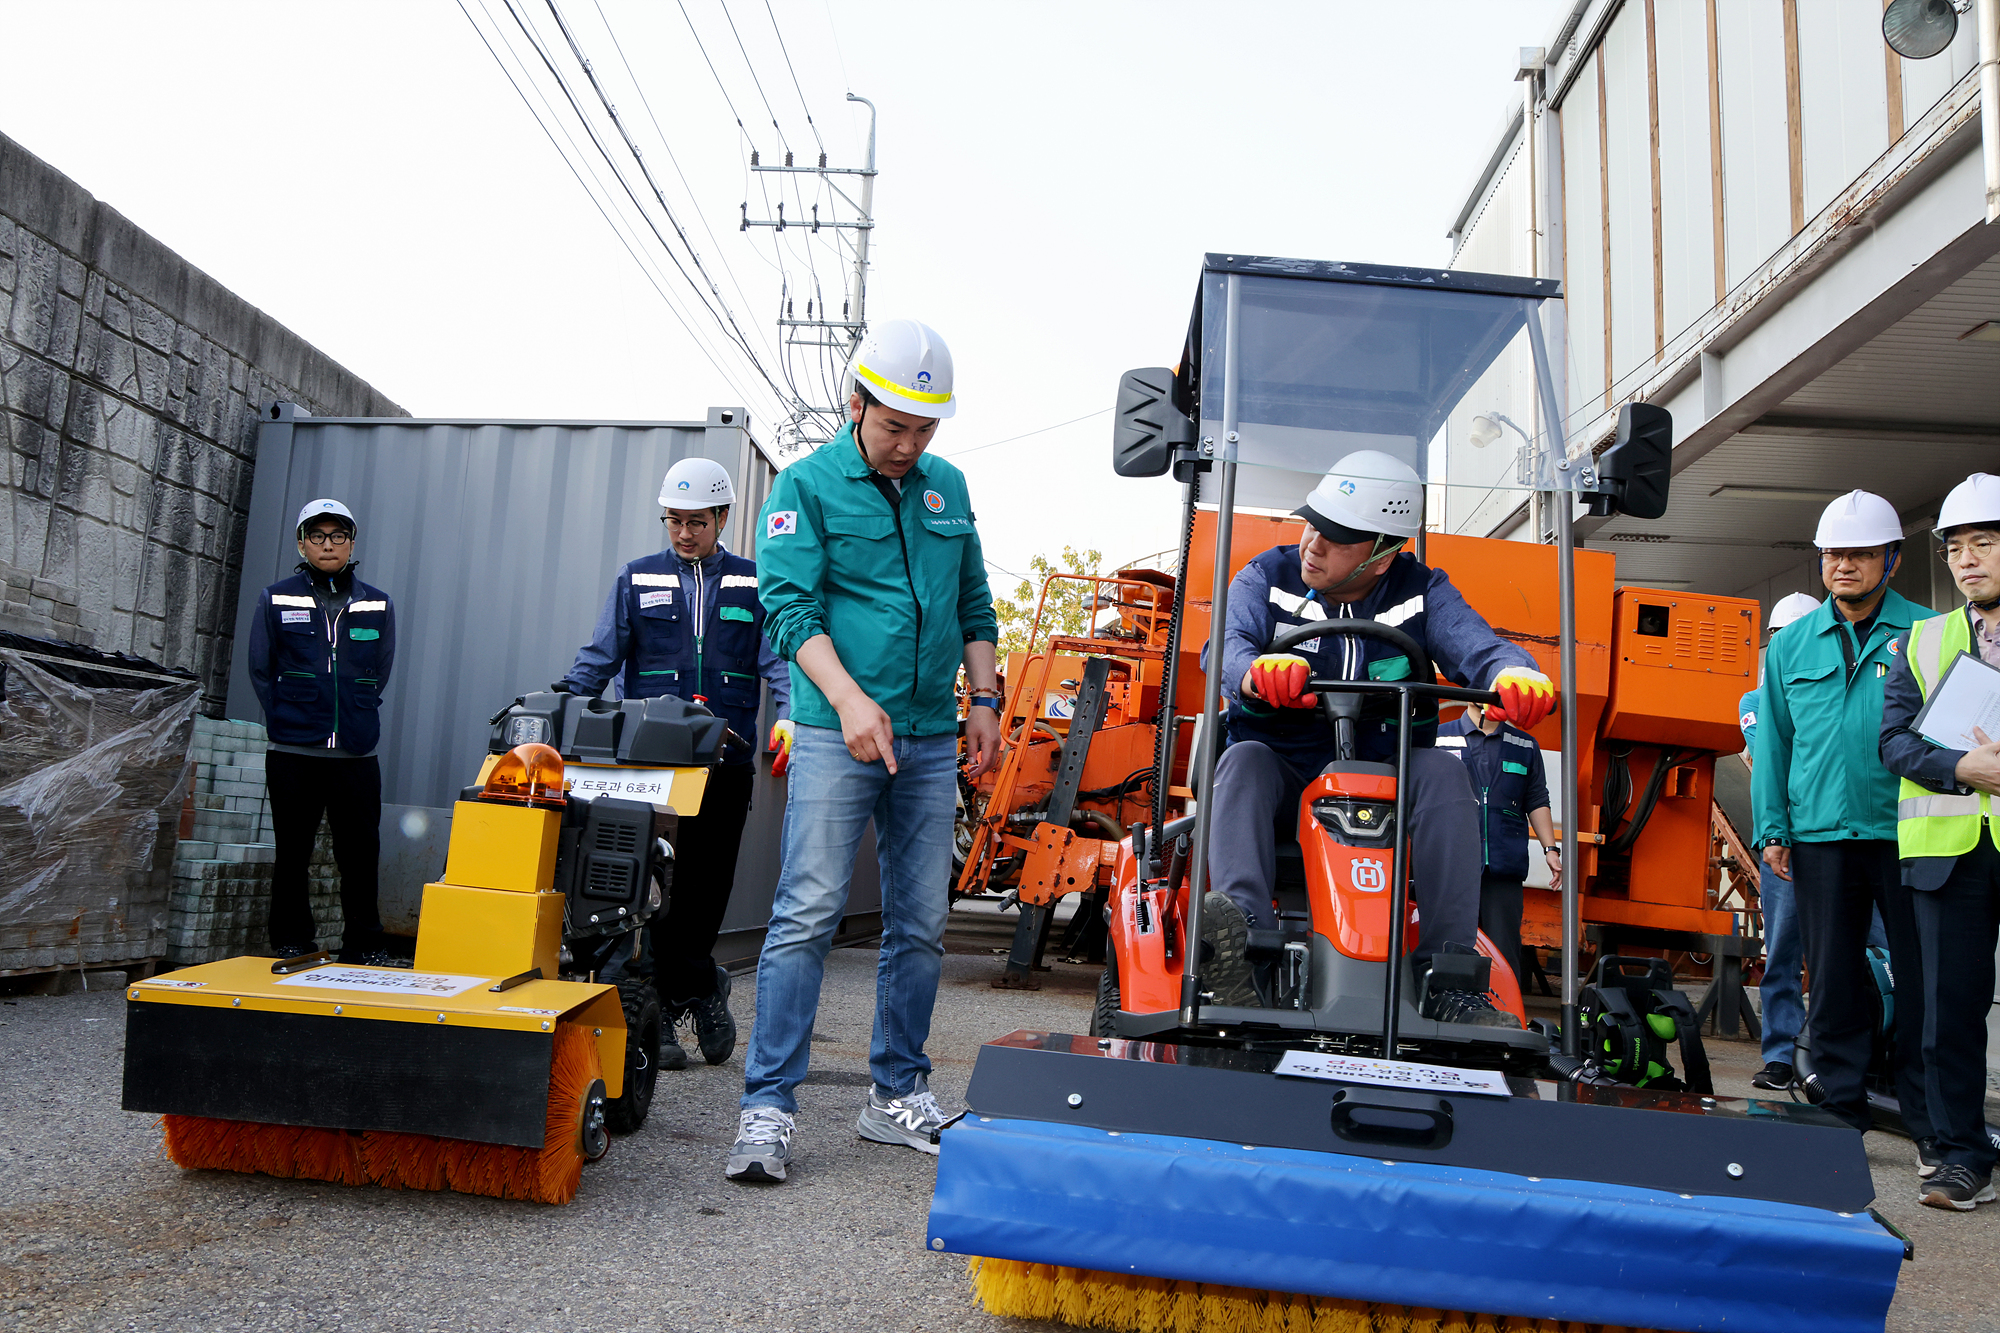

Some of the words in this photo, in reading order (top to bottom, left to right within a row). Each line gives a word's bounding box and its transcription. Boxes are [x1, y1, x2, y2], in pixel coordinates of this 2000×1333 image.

[911, 382, 933, 393] 도봉구
[581, 780, 622, 793] 도로과
[626, 782, 661, 795] 6호차
